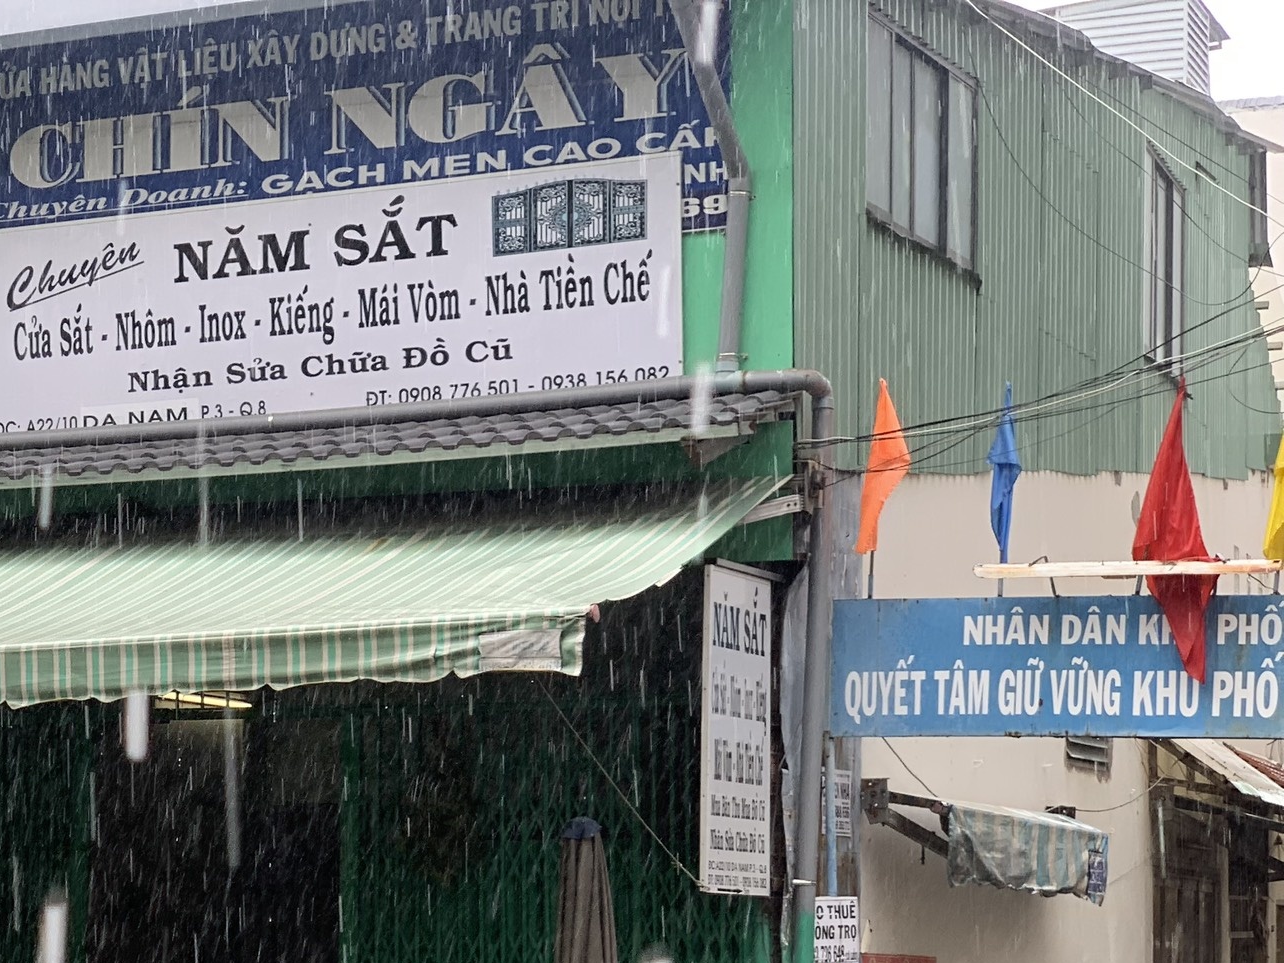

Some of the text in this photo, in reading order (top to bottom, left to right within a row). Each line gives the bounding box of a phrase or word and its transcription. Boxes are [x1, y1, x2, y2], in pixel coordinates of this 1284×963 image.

[40, 55, 110, 95] HÀNG
[119, 48, 168, 89] VẬT
[177, 37, 237, 82] LIỆU
[247, 29, 300, 69] XÂY
[310, 22, 386, 64] DỰNG
[395, 20, 417, 49] &
[426, 4, 522, 48] TRANG
[10, 42, 688, 189] CHÍN NGÂY
[121, 178, 247, 207] Doanh:
[261, 162, 386, 196] GẠCH
[403, 150, 508, 181] MEN
[524, 138, 622, 167] CAO
[6, 194, 459, 308] Chuyên NĂM SẮT
[14, 315, 53, 361] Cửa
[59, 303, 94, 357] Sắt
[116, 308, 177, 351] Nhôm
[198, 304, 247, 344] Inox
[269, 285, 335, 345] Kiếng
[358, 283, 401, 329] Mái
[407, 279, 461, 324] Vòm
[485, 270, 531, 316] Nhà
[539, 253, 595, 311] Tiền
[604, 248, 653, 306] Chế
[128, 338, 513, 394] Nhận Sửa Chữa Đồ Cũ
[399, 386, 443, 404] 0908
[450, 382, 482, 400] 776
[488, 378, 519, 396] 501
[542, 373, 587, 391] 0938
[596, 369, 628, 387] 156
[712, 586, 768, 658] NĂM SẮT
[963, 601, 1284, 646] NHÂN DÂN KH PHỐ
[844, 651, 1284, 725] QUYẾT TÂM GIỮ VỮNG KHU PHỐ
[827, 900, 856, 919] THUÊ
[837, 924, 857, 942] TRỌ
